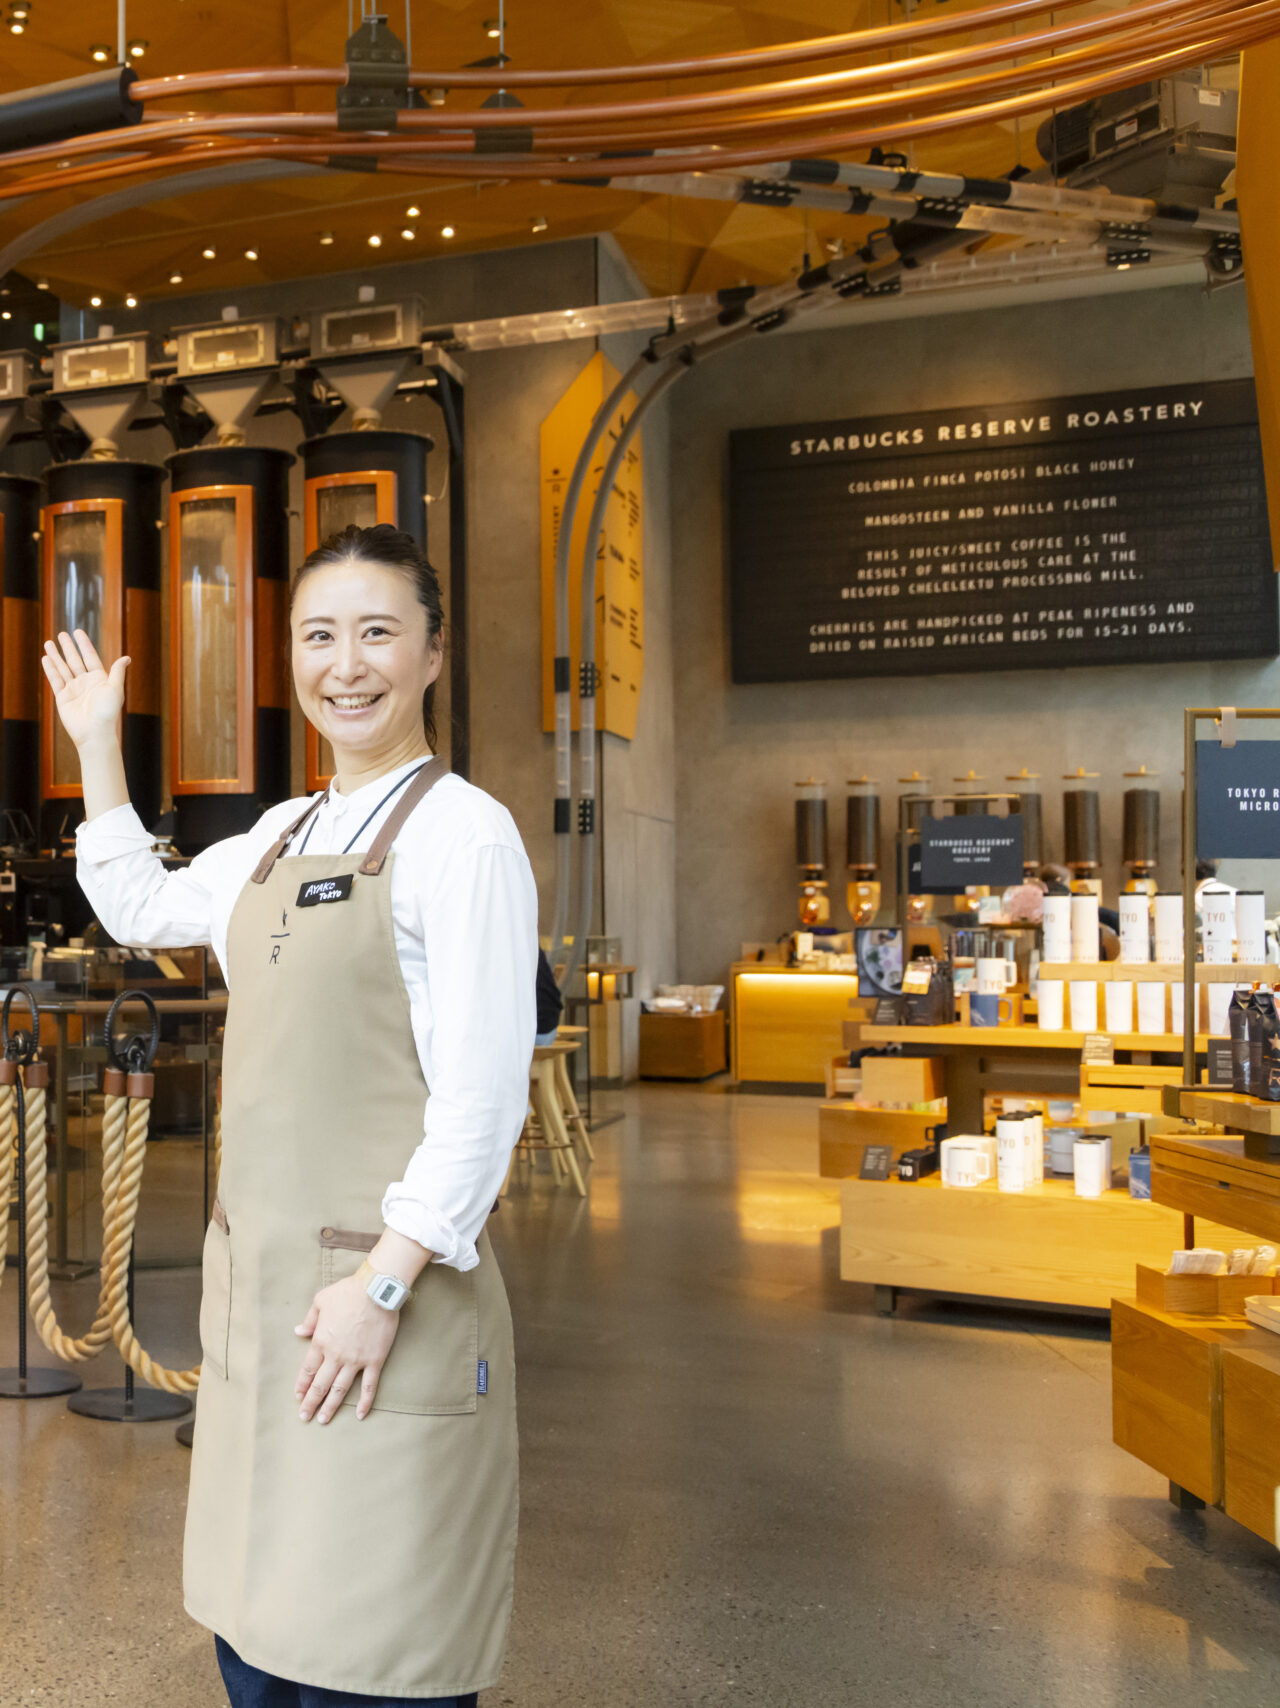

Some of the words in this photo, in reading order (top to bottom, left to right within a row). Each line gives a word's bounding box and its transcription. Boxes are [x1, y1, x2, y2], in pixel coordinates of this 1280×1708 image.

[790, 428, 924, 456] STARBUCKS
[938, 416, 1052, 442] RESERVE
[1067, 400, 1203, 429] ROASTERY
[848, 477, 915, 494] COLOMBIA
[923, 472, 966, 487] FINCA
[974, 467, 1025, 482] POTOSI
[1036, 463, 1079, 478] BLACK
[1090, 457, 1135, 472] HONEY
[865, 510, 950, 528] MANGOSTEEN
[958, 506, 984, 519] AND
[992, 501, 1054, 517] VANILLA
[867, 549, 899, 563] THIS
[1011, 536, 1063, 552] COFFEE
[1075, 535, 1091, 547] IS
[1101, 532, 1127, 544] THE
[857, 566, 907, 581] RESULT
[916, 564, 932, 576] OF
[941, 558, 1028, 574] METICULOUS
[1038, 554, 1073, 567] CARE
[1083, 552, 1100, 564] AT
[1111, 549, 1137, 562] THE
[841, 584, 900, 599] BELOVED
[1101, 568, 1144, 582] MILL.
[810, 620, 875, 636] CHERRIES
[884, 618, 909, 631] ARE
[917, 613, 1003, 629] HANDPICKED
[1012, 612, 1029, 623] AT
[1039, 609, 1074, 622] PEAK
[1084, 603, 1156, 620] RIPENESS
[1167, 602, 1195, 614] AND
[809, 639, 851, 653] DRIED
[859, 638, 876, 650] ON
[883, 634, 935, 649] RAISED
[943, 631, 1004, 646] AFRICAN
[1012, 628, 1048, 642] BEDS
[1057, 626, 1084, 639] FOR
[1095, 622, 1137, 637] 15-21
[1148, 620, 1192, 635] DAYS.
[1227, 787, 1266, 798] TOKYO
[1239, 801, 1280, 811] MICRO
[305, 882, 336, 898] AYAKO
